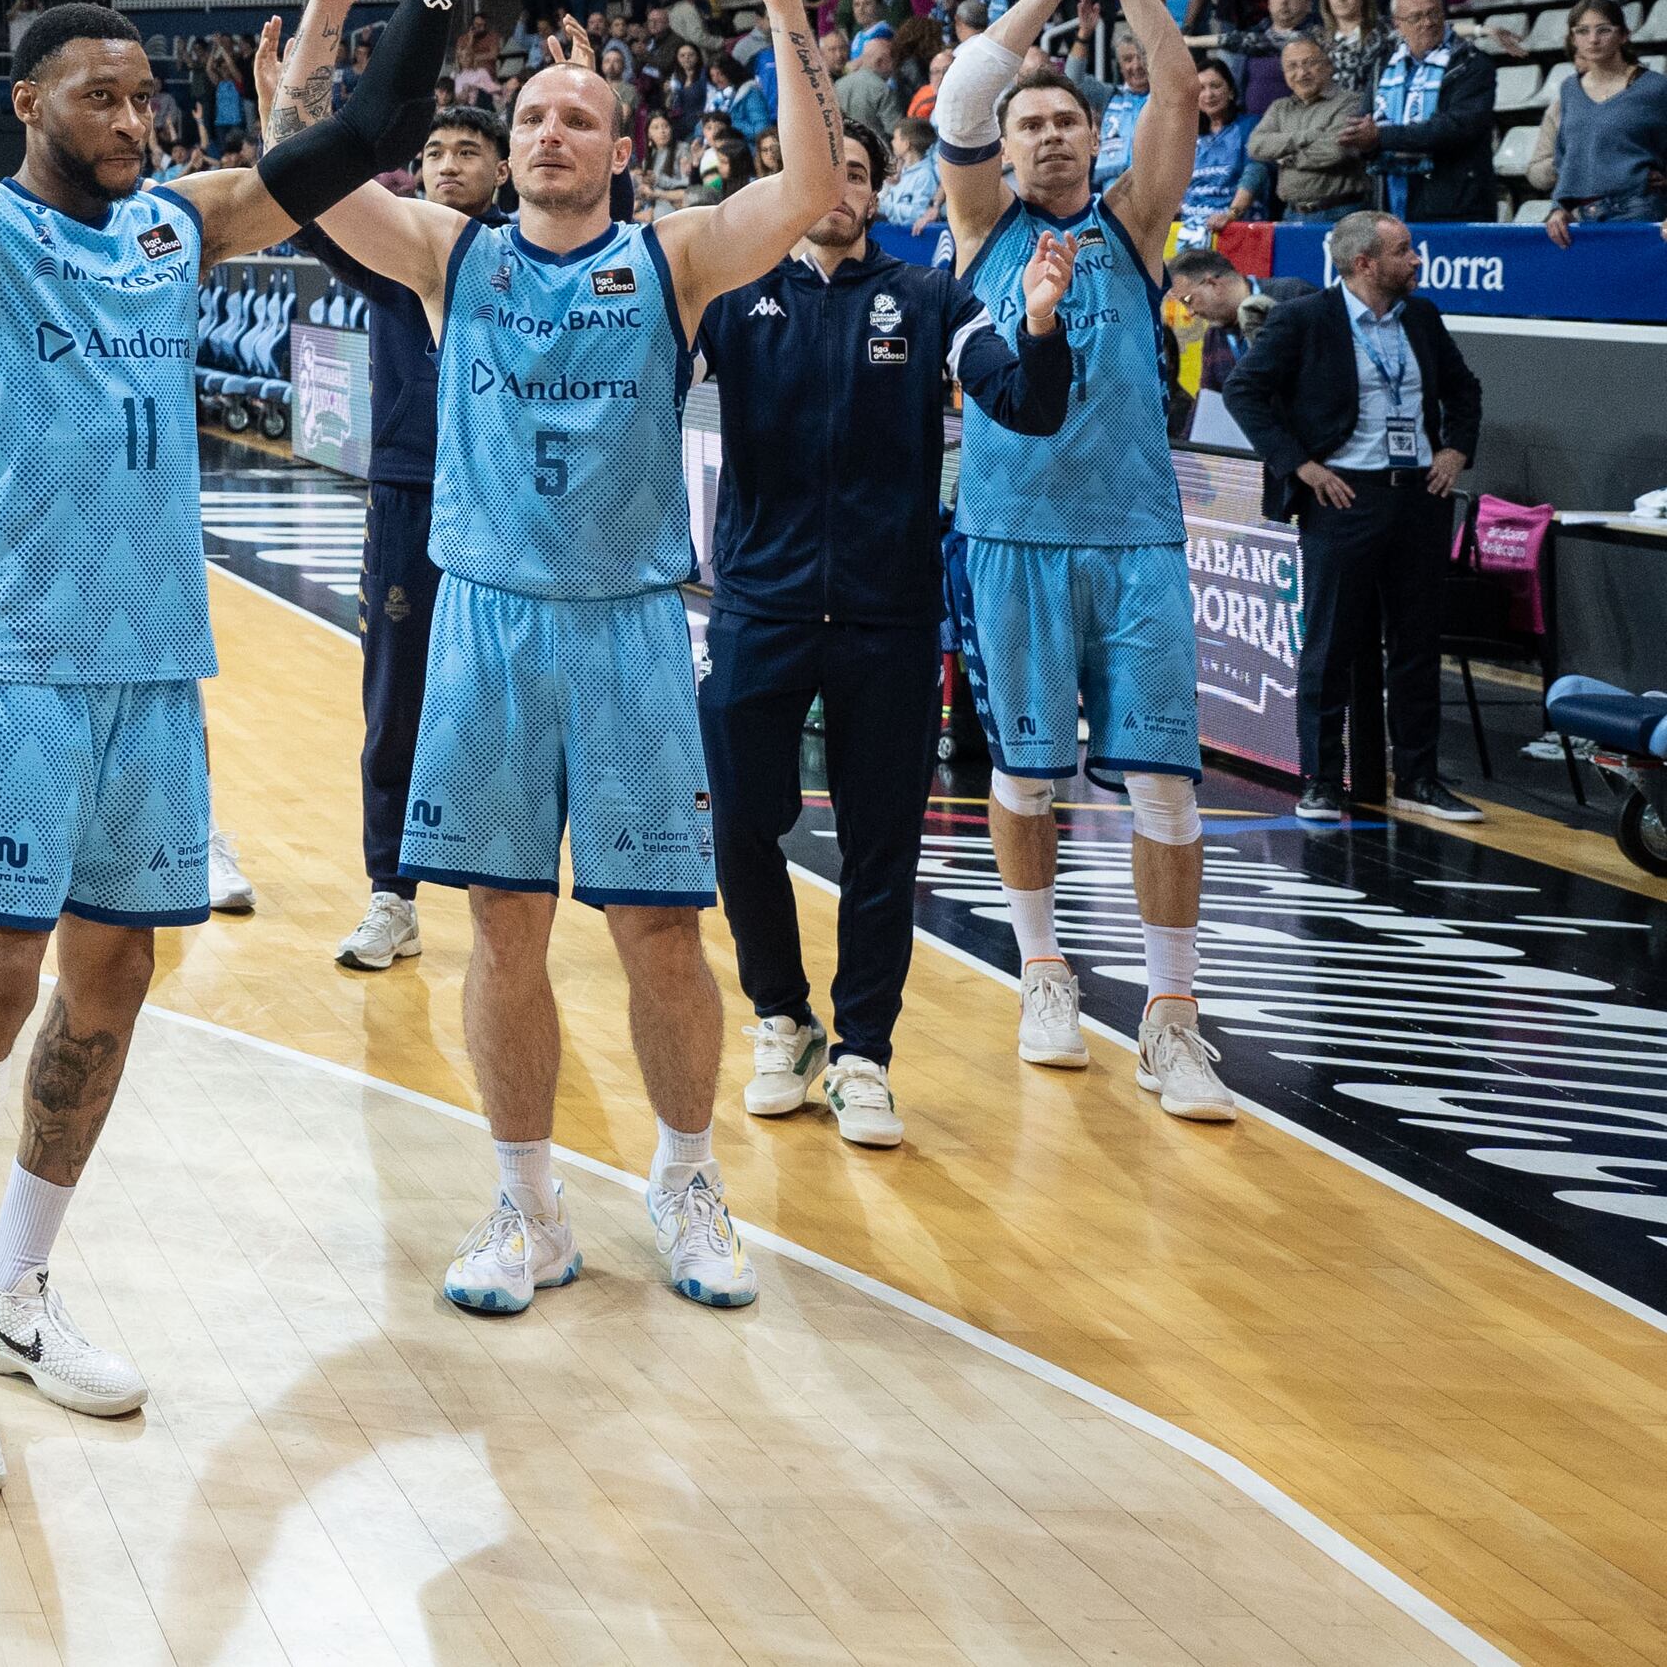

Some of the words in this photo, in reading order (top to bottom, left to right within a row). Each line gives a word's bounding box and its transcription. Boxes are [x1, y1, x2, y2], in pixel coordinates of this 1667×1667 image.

[141, 236, 162, 250] liga
[148, 238, 181, 256] endesa
[595, 276, 614, 286] liga
[596, 282, 635, 292] endesa
[84, 327, 191, 361] Andorra
[873, 345, 888, 354] liga
[873, 351, 905, 360] endesa
[499, 370, 639, 401] Andorra
[122, 397, 157, 471] 11
[535, 430, 568, 497] 5
[642, 829, 689, 841] andorra
[642, 841, 692, 854] telecom
[15, 871, 26, 884] la
